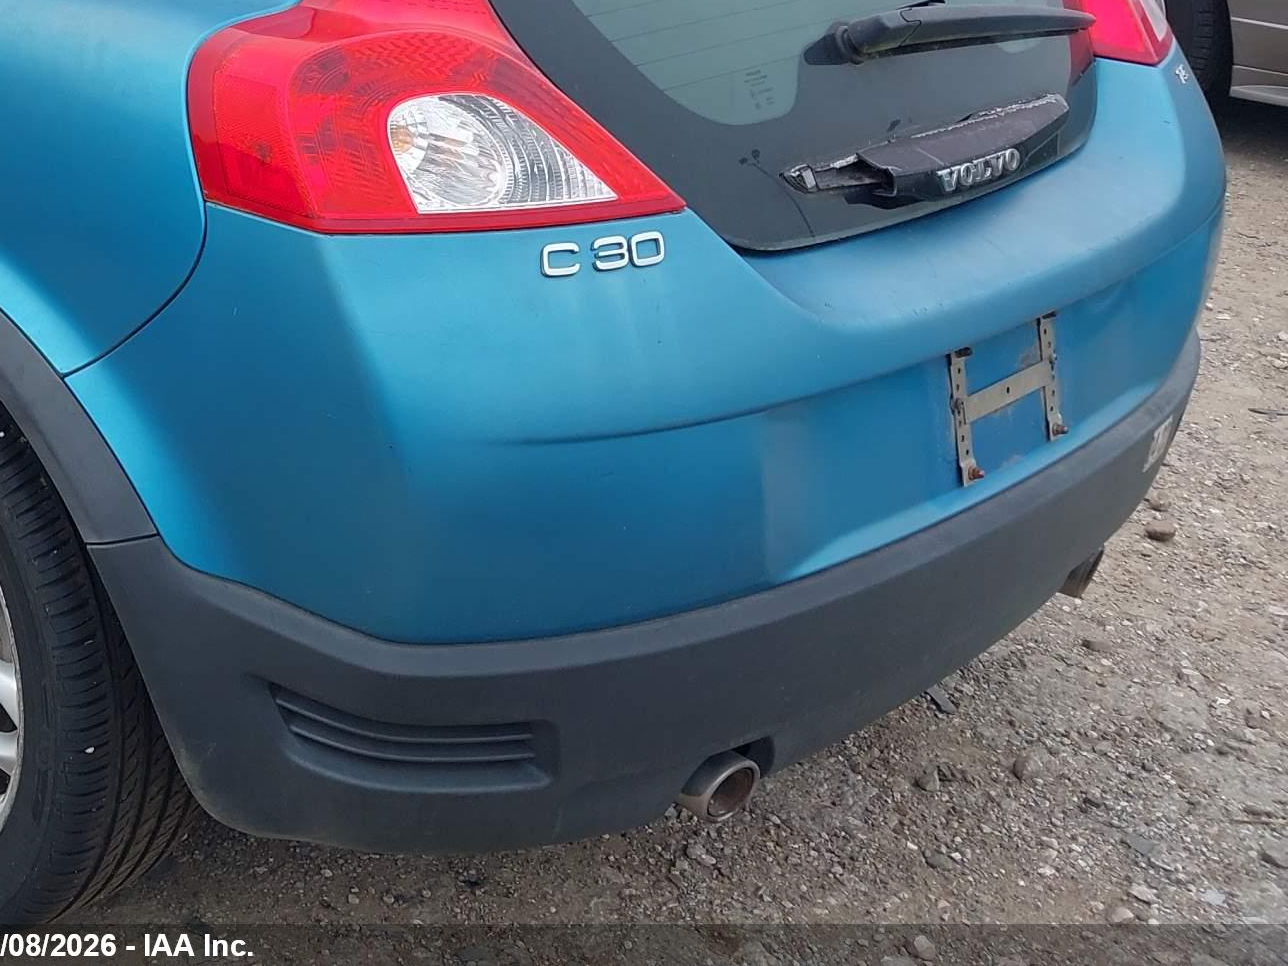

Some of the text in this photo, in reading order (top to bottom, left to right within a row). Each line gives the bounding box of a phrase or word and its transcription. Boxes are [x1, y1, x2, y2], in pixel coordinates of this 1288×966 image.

[936, 147, 1021, 192] VOLVO
[541, 231, 665, 277] C 30
